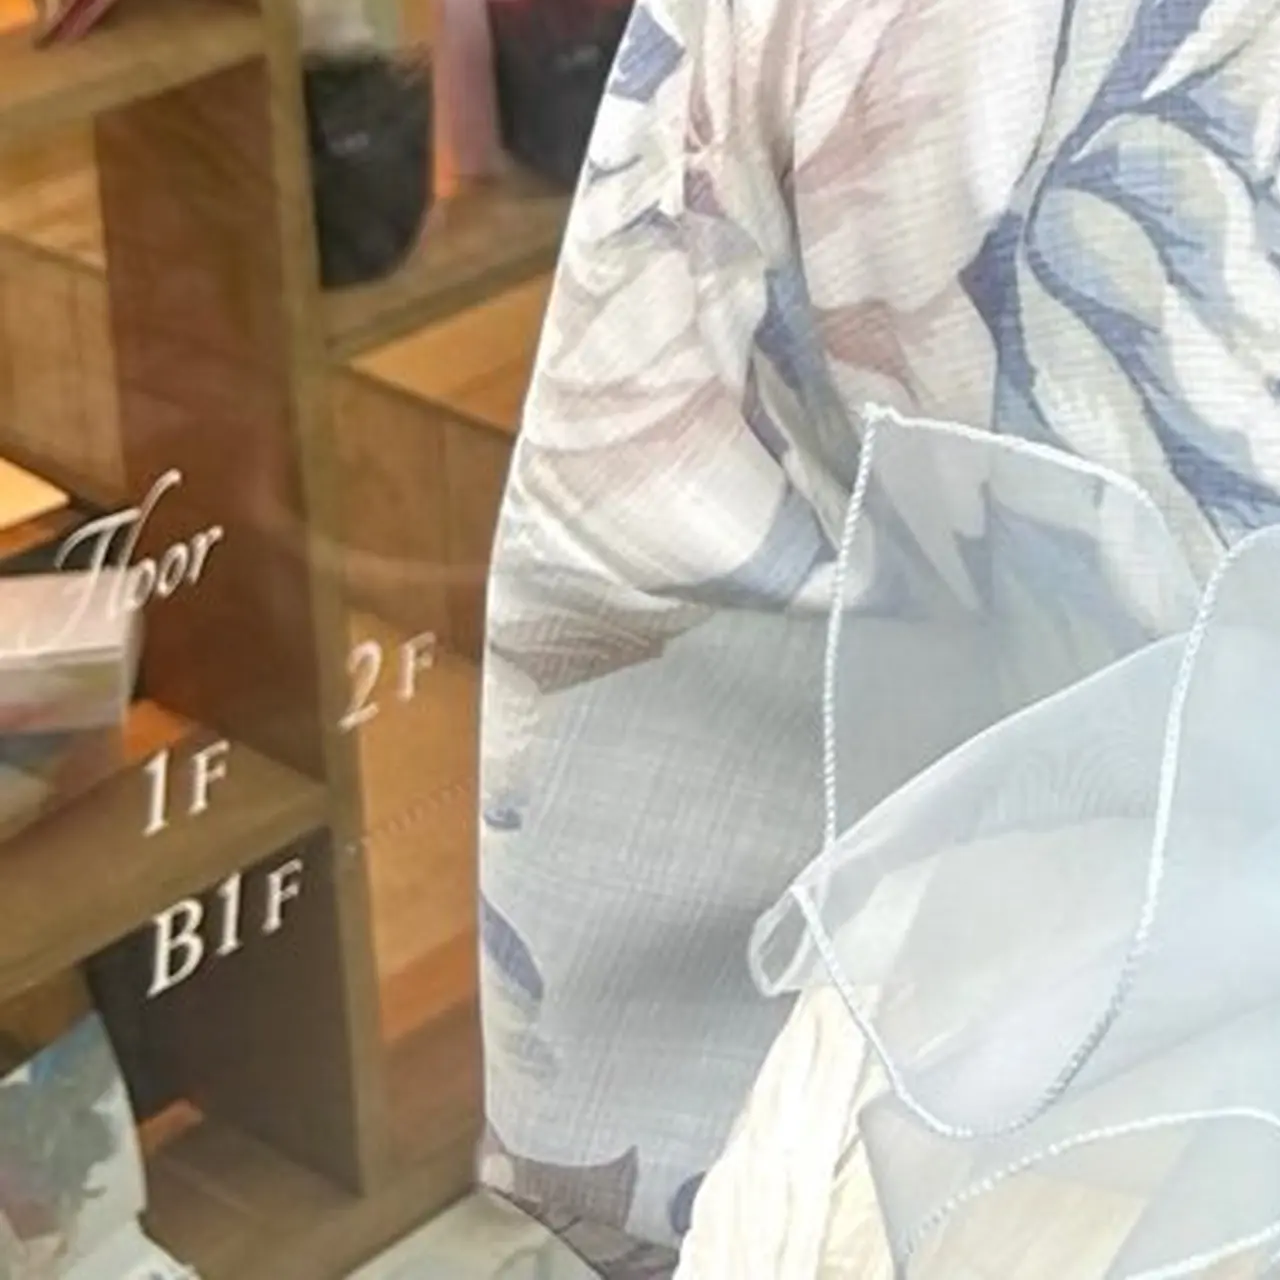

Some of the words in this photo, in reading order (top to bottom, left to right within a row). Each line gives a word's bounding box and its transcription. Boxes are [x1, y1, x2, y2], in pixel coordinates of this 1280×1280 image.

[55, 468, 224, 643] Floor
[338, 631, 436, 731] 2F
[142, 740, 230, 837] 1F
[146, 858, 303, 998] B1F
